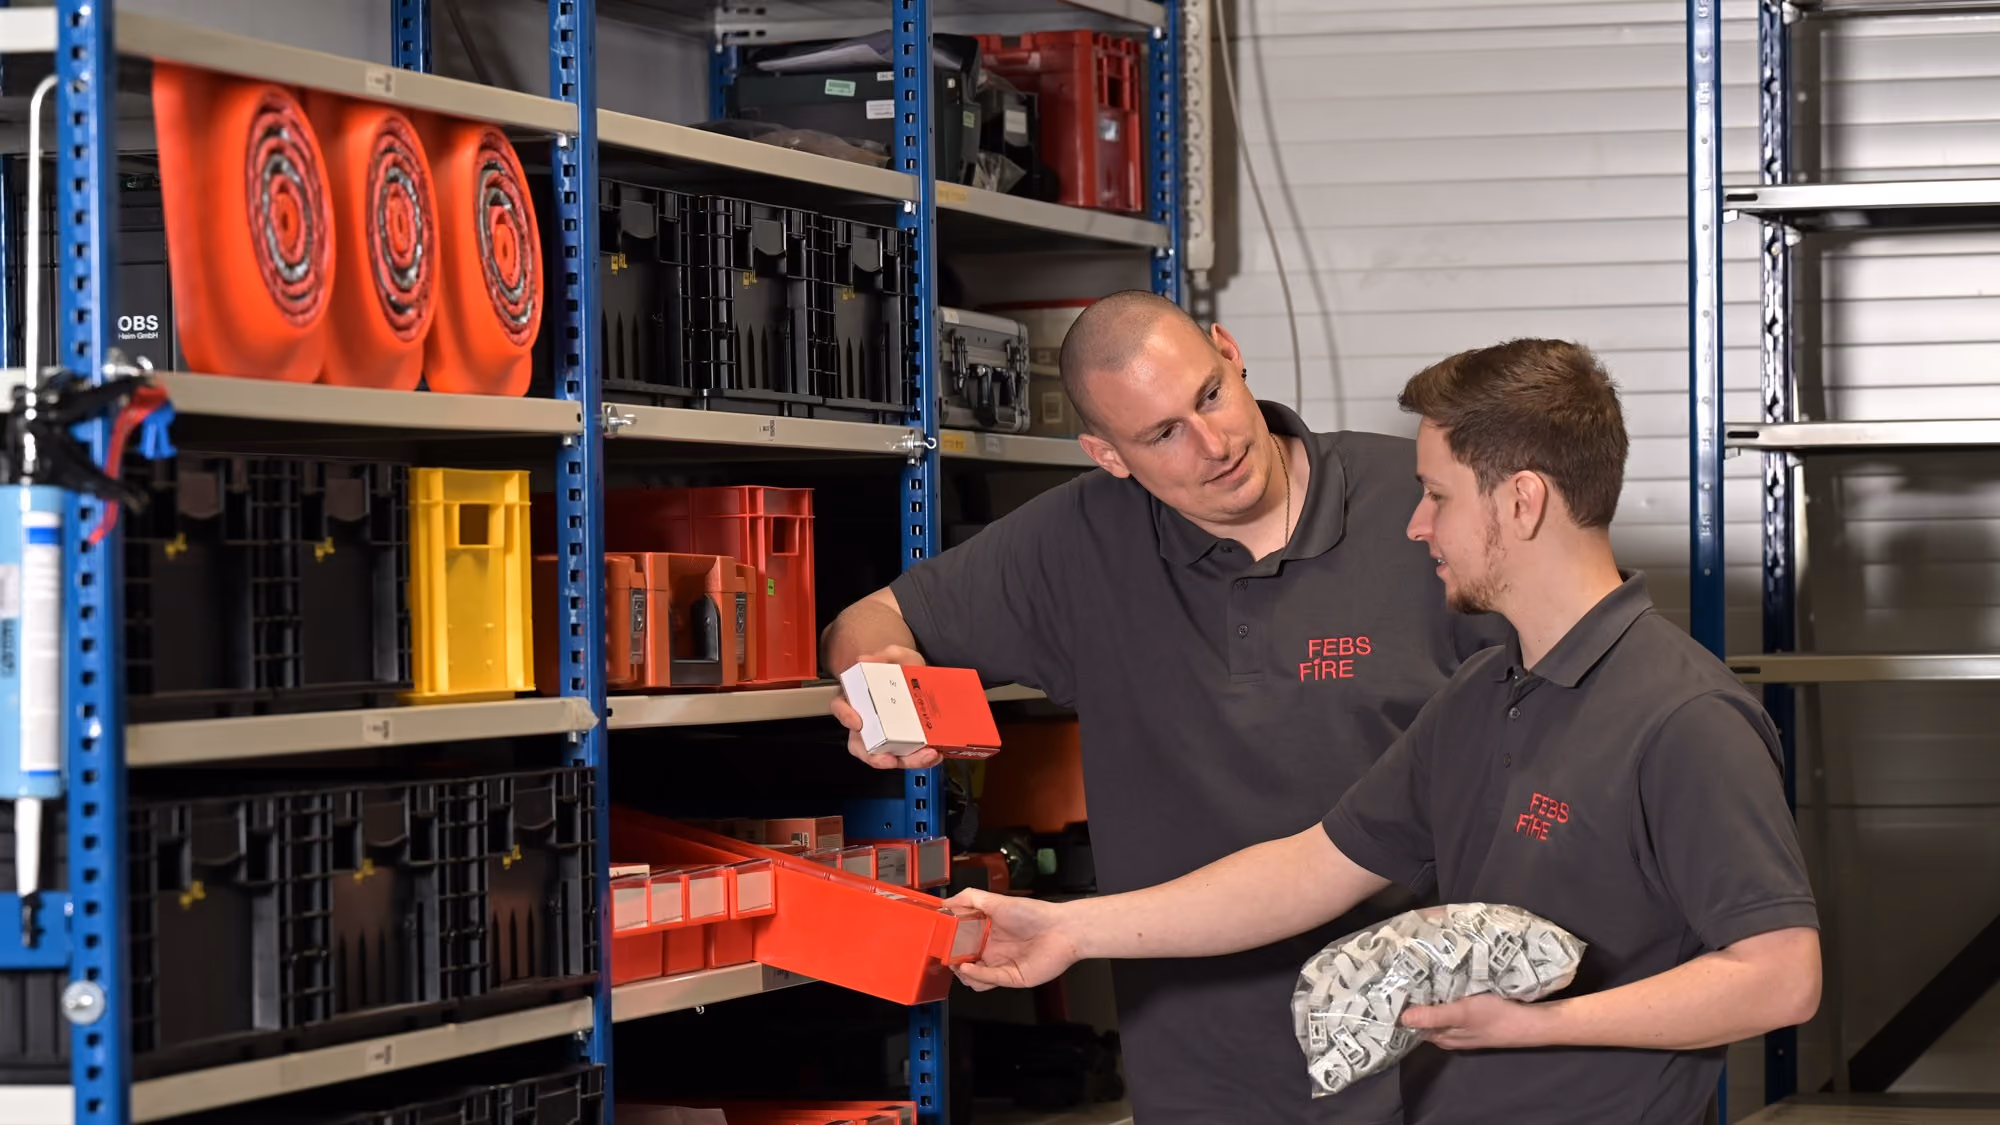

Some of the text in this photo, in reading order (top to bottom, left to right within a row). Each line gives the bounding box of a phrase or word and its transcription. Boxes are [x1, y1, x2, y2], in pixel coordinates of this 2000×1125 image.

[137, 332, 159, 340] GmbH
[1308, 636, 1372, 658] FEBS
[1529, 792, 1569, 823] FEBS
